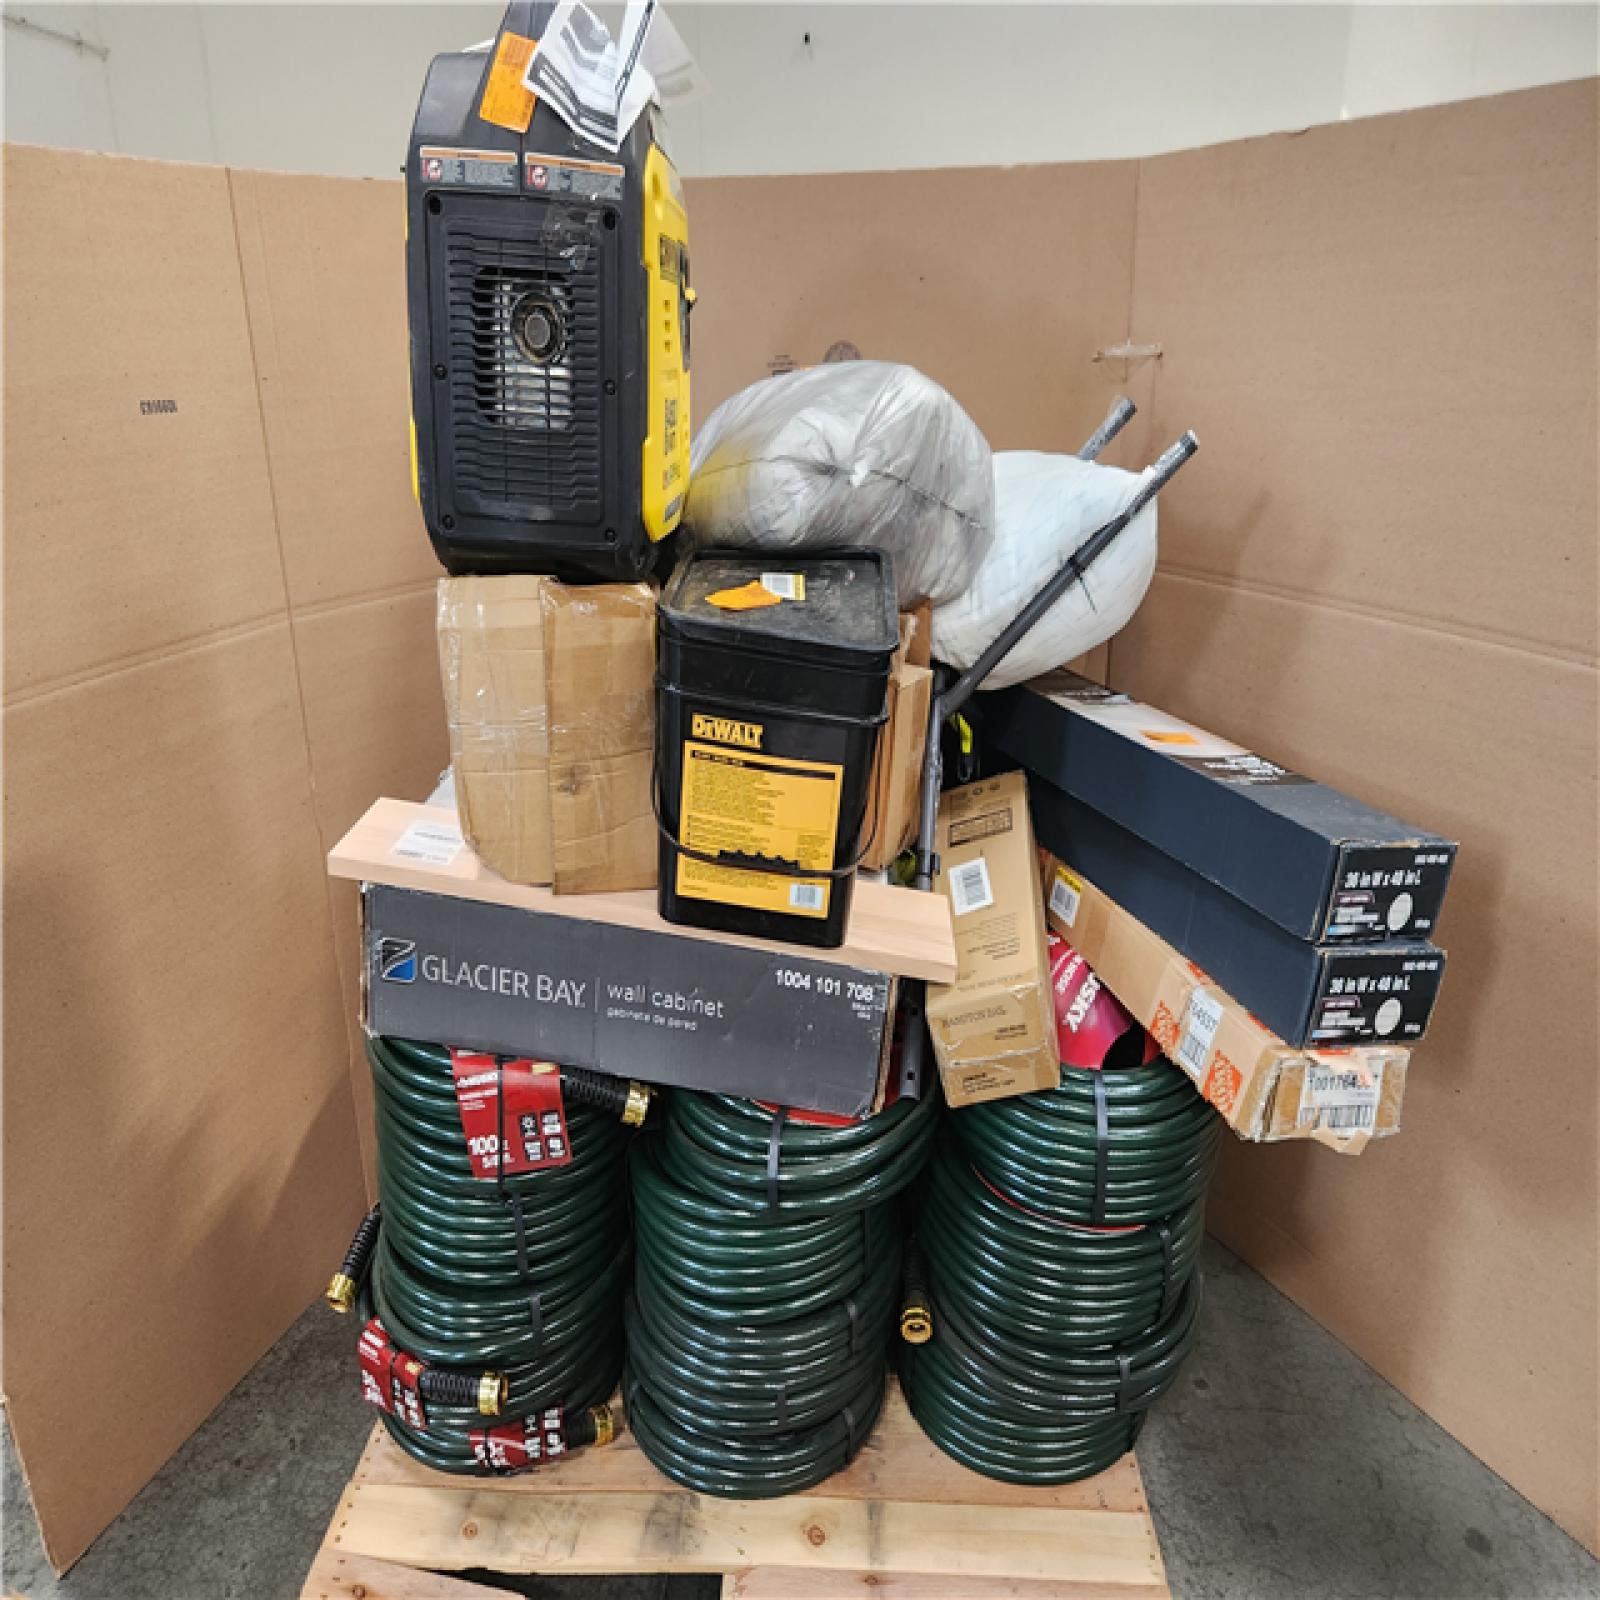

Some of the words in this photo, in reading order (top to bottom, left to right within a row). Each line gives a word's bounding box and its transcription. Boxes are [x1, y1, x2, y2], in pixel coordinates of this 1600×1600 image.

[421, 954, 531, 999] GLACIER
[536, 974, 588, 1009] BAY
[775, 969, 811, 991] 1004
[815, 976, 841, 997] 101
[606, 984, 646, 1004] wall
[651, 987, 724, 1019] cabinet
